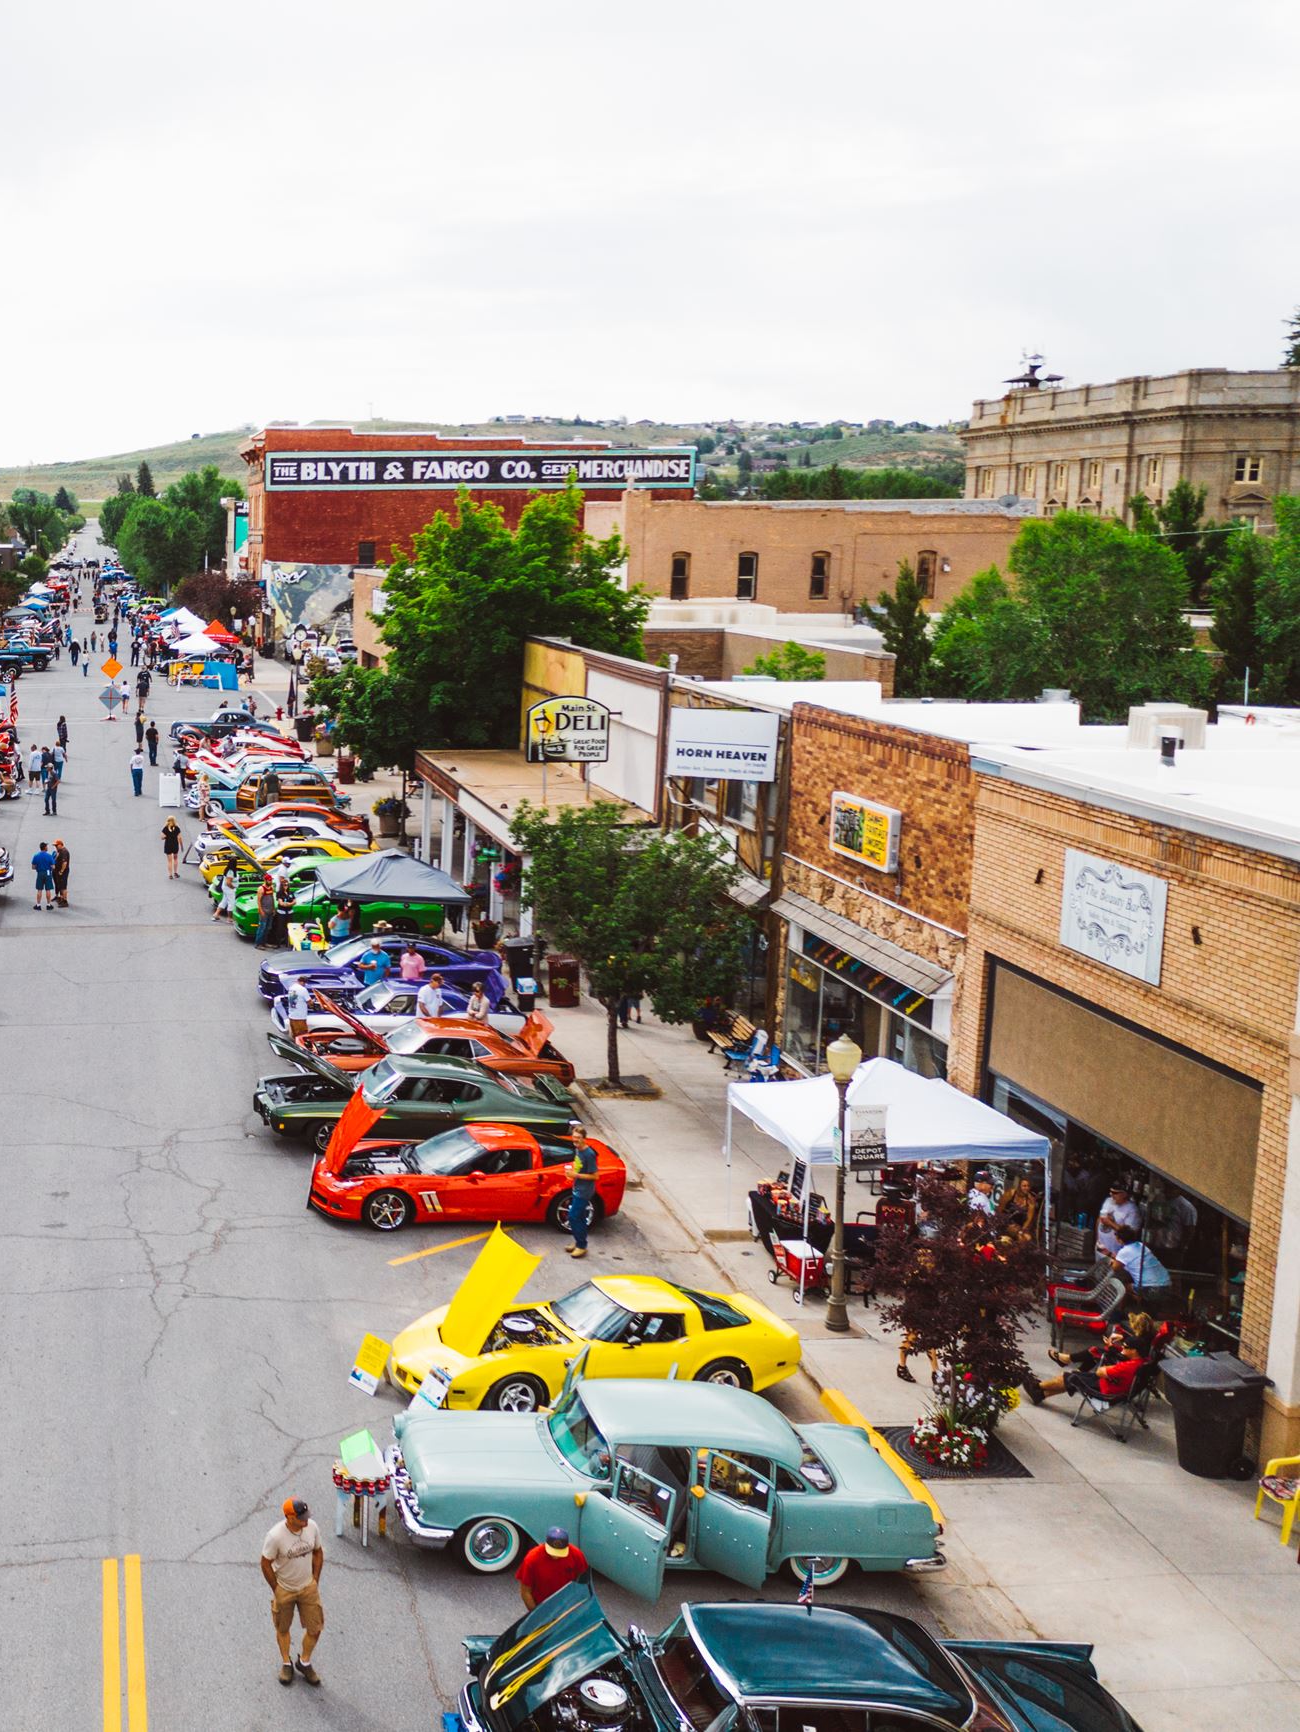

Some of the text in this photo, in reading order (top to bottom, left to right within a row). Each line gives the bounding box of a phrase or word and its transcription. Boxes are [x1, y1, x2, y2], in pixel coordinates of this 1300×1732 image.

[273, 466, 298, 477] THE
[300, 462, 376, 480] BLYTH
[383, 461, 404, 480] &
[412, 461, 490, 480] FARGO
[500, 460, 537, 479] CO.
[579, 460, 690, 478] MERCHANDISE
[561, 704, 585, 712] Main
[555, 712, 606, 731] DELI
[676, 748, 768, 762] HORN HEAVEN
[854, 1147, 883, 1155] DEPOT
